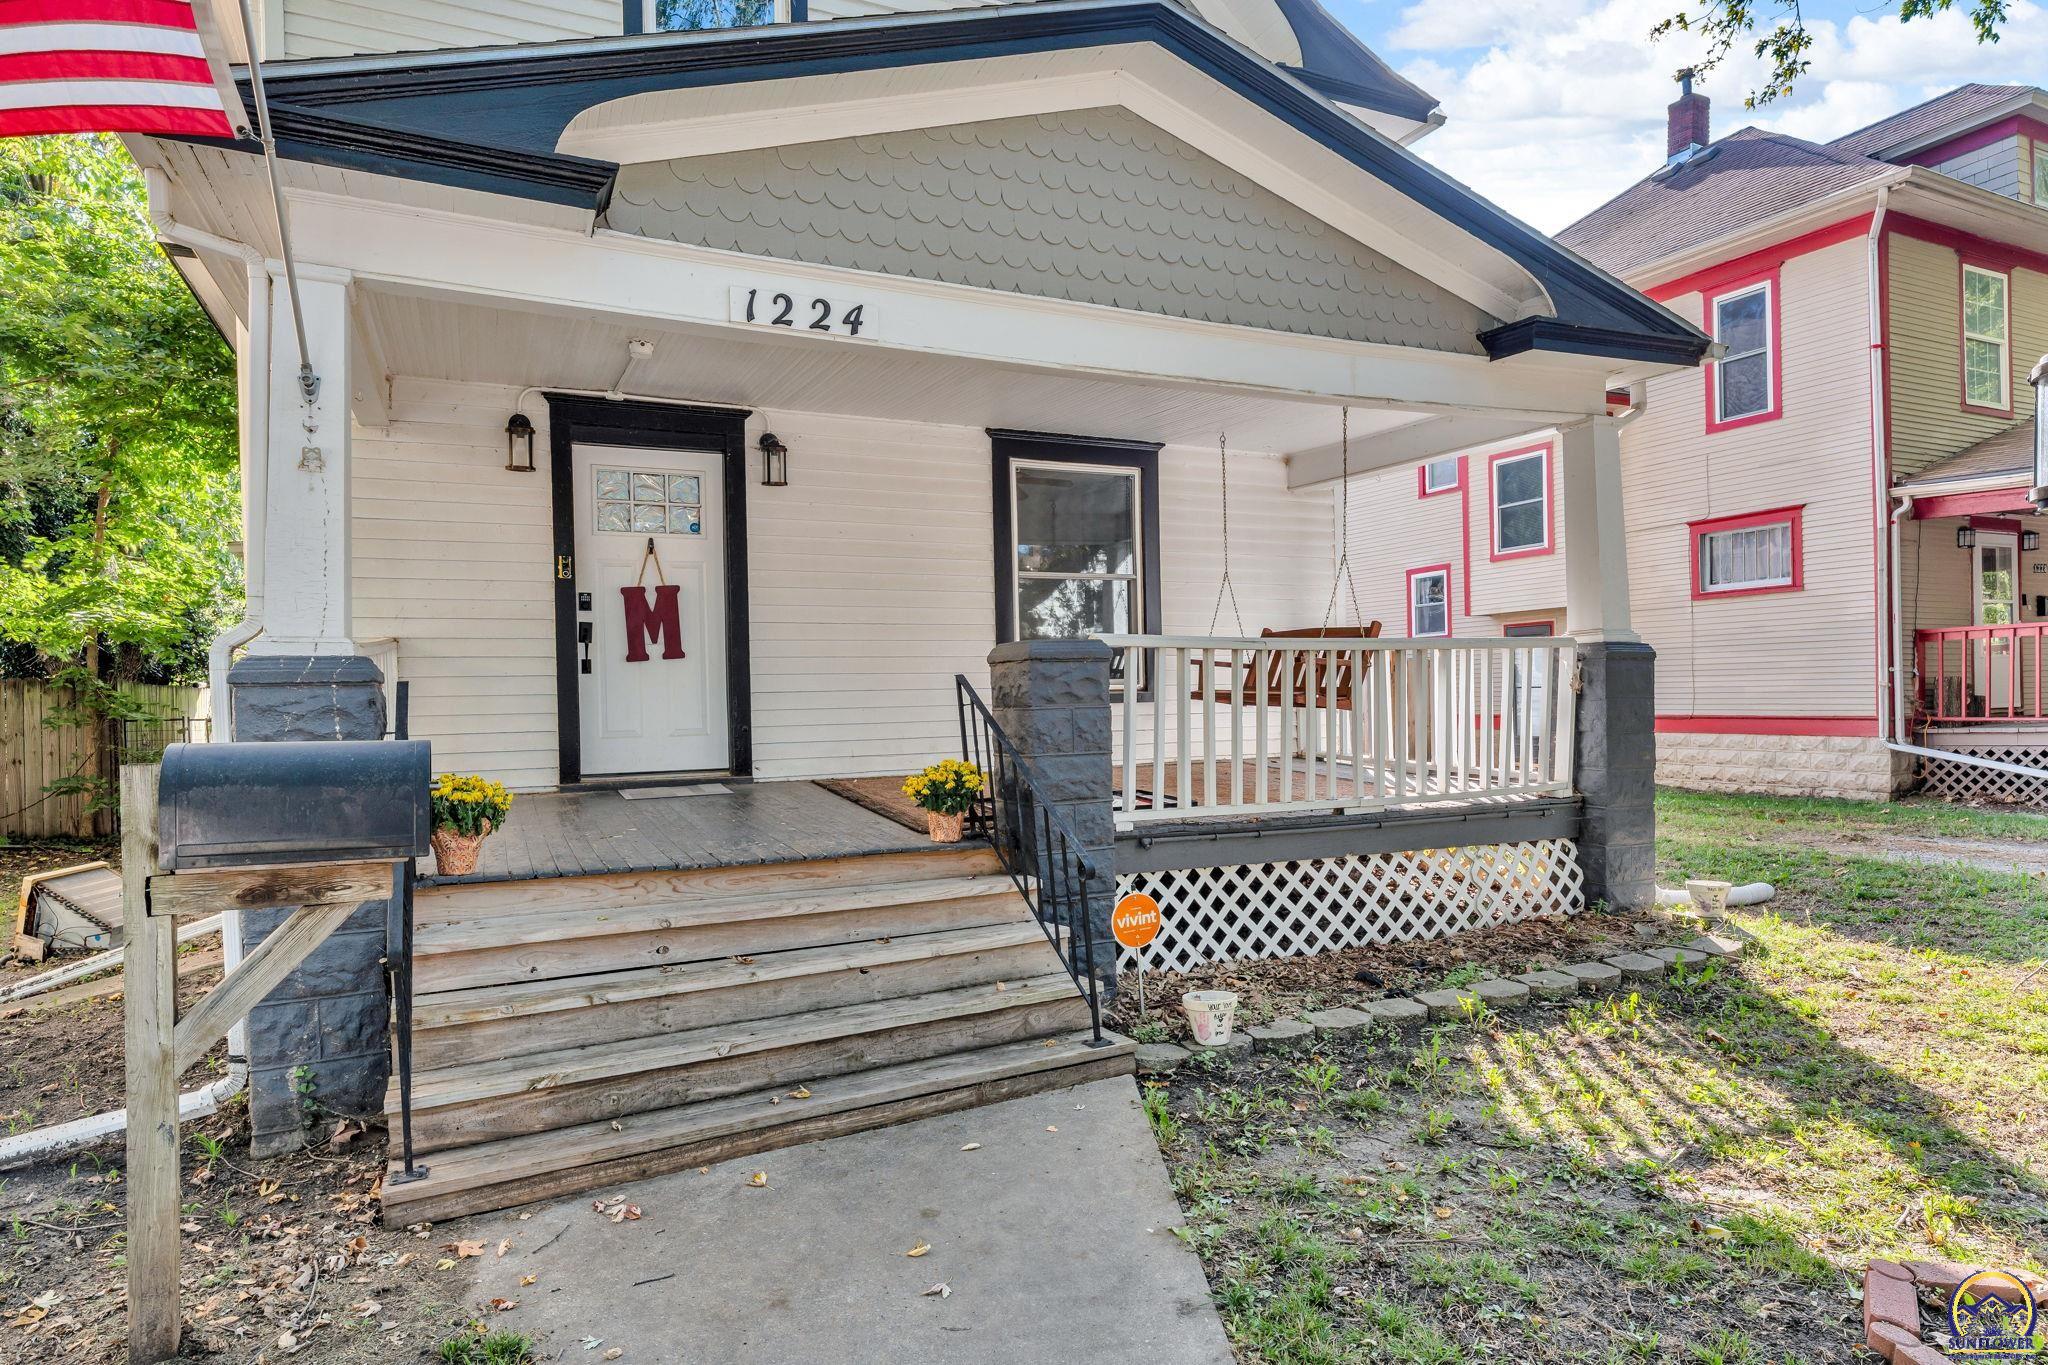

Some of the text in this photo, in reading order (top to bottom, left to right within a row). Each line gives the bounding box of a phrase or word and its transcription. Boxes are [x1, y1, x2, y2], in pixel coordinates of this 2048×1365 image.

[746, 289, 863, 336] 1224
[620, 585, 686, 662] M
[1117, 910, 1157, 929] vivint
